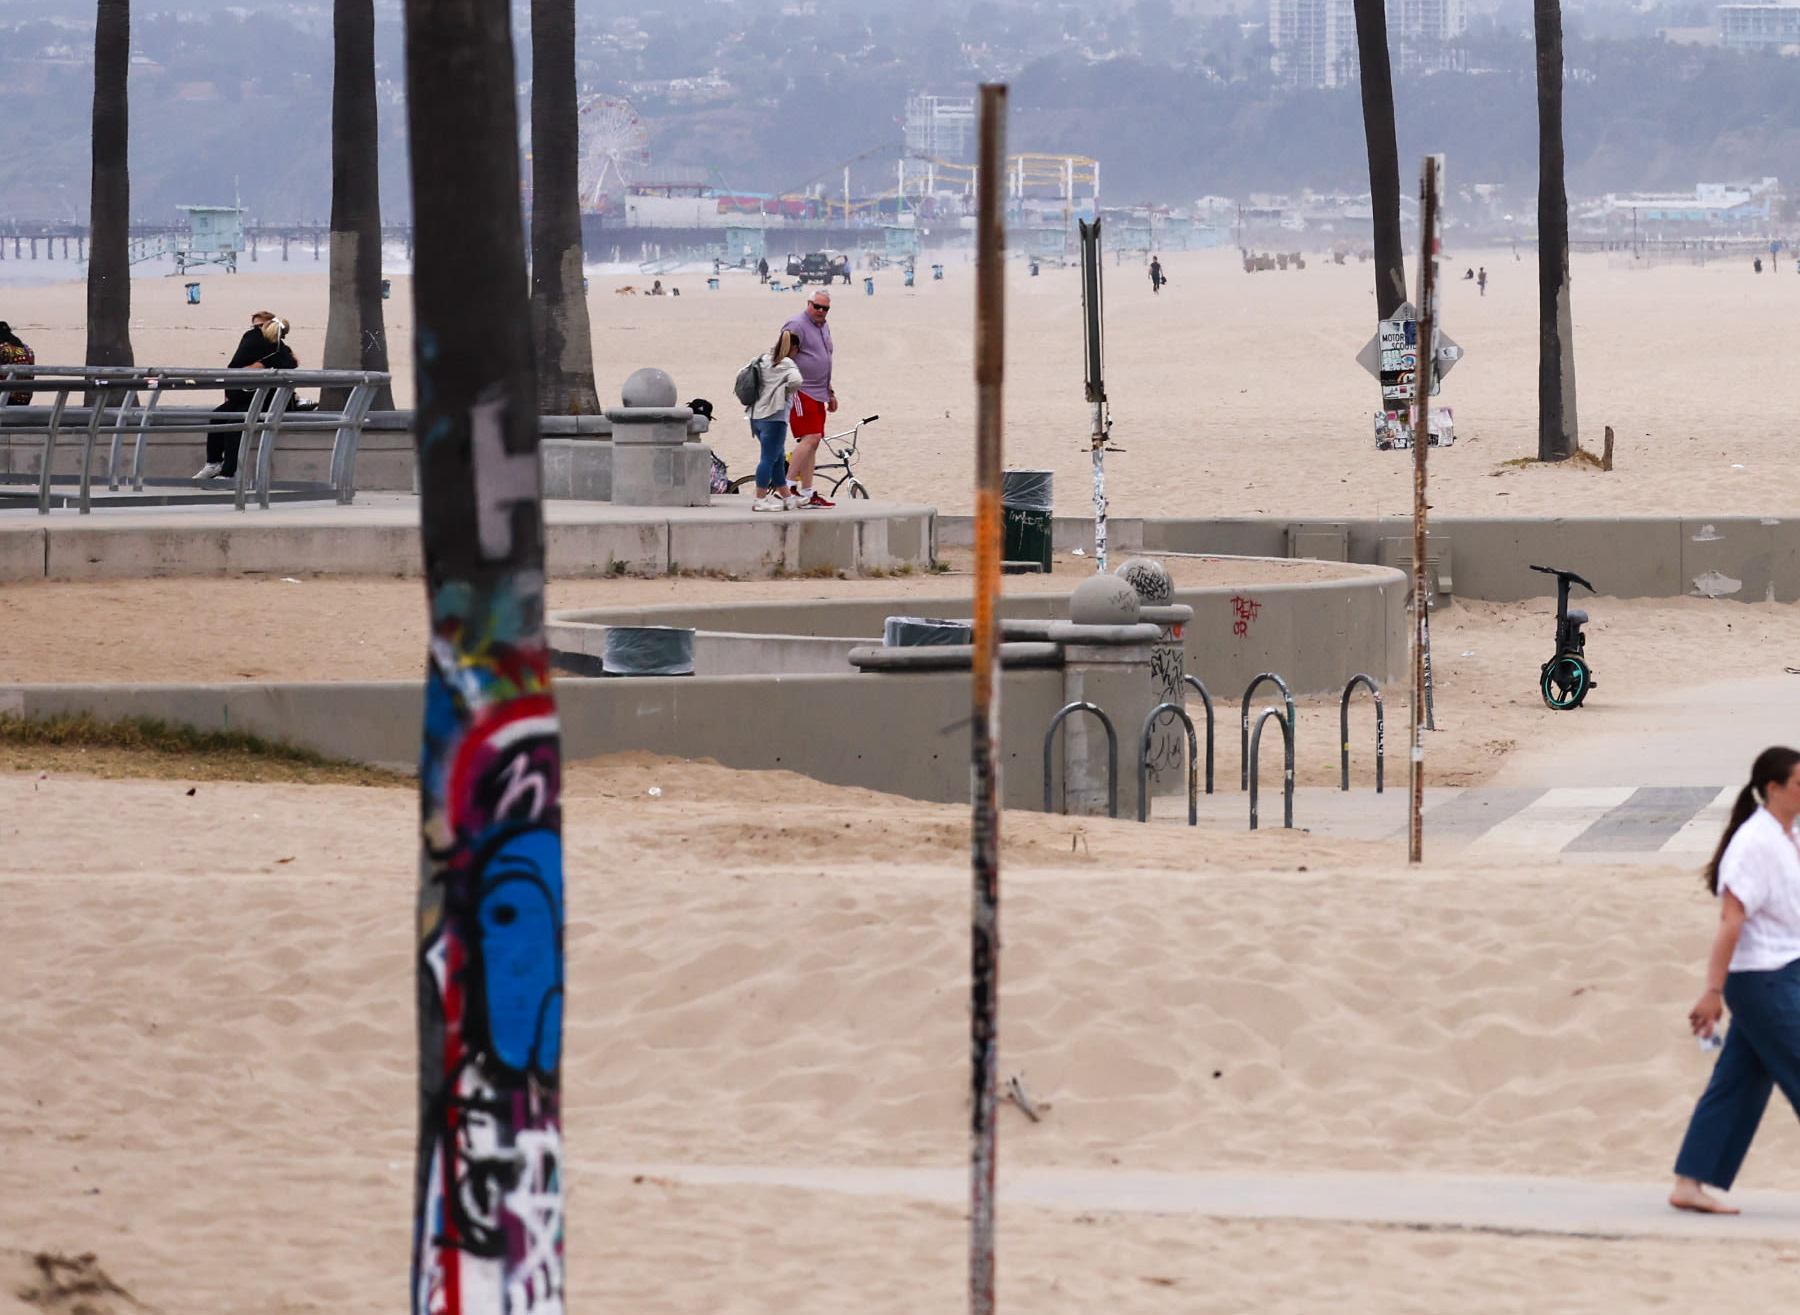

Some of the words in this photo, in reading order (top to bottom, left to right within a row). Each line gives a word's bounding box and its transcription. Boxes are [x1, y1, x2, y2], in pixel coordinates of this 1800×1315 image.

[1382, 333, 1405, 342] MOTOR
[1391, 342, 1417, 350] SCOOTE
[1233, 620, 1248, 639] OR
